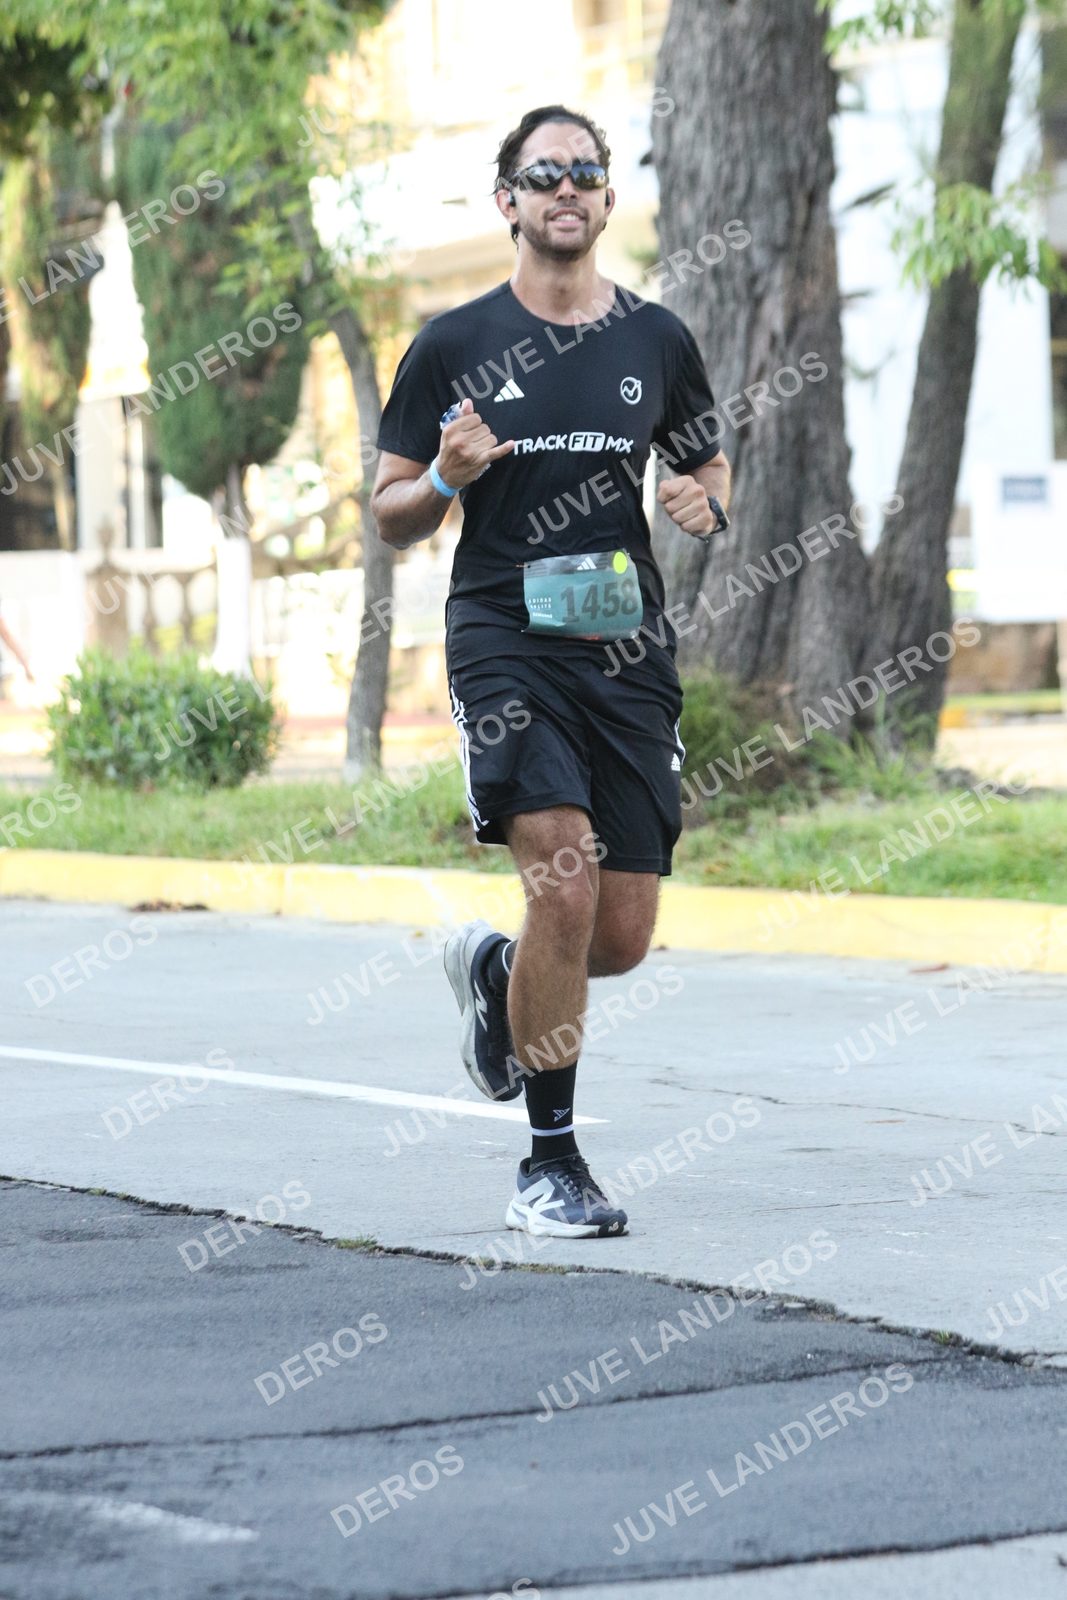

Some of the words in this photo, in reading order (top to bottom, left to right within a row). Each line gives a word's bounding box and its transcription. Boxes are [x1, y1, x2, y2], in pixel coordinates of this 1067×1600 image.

[514, 434, 567, 455] TRACK
[570, 432, 604, 451] FIT
[606, 436, 633, 454] MX
[560, 579, 638, 622] 1458
